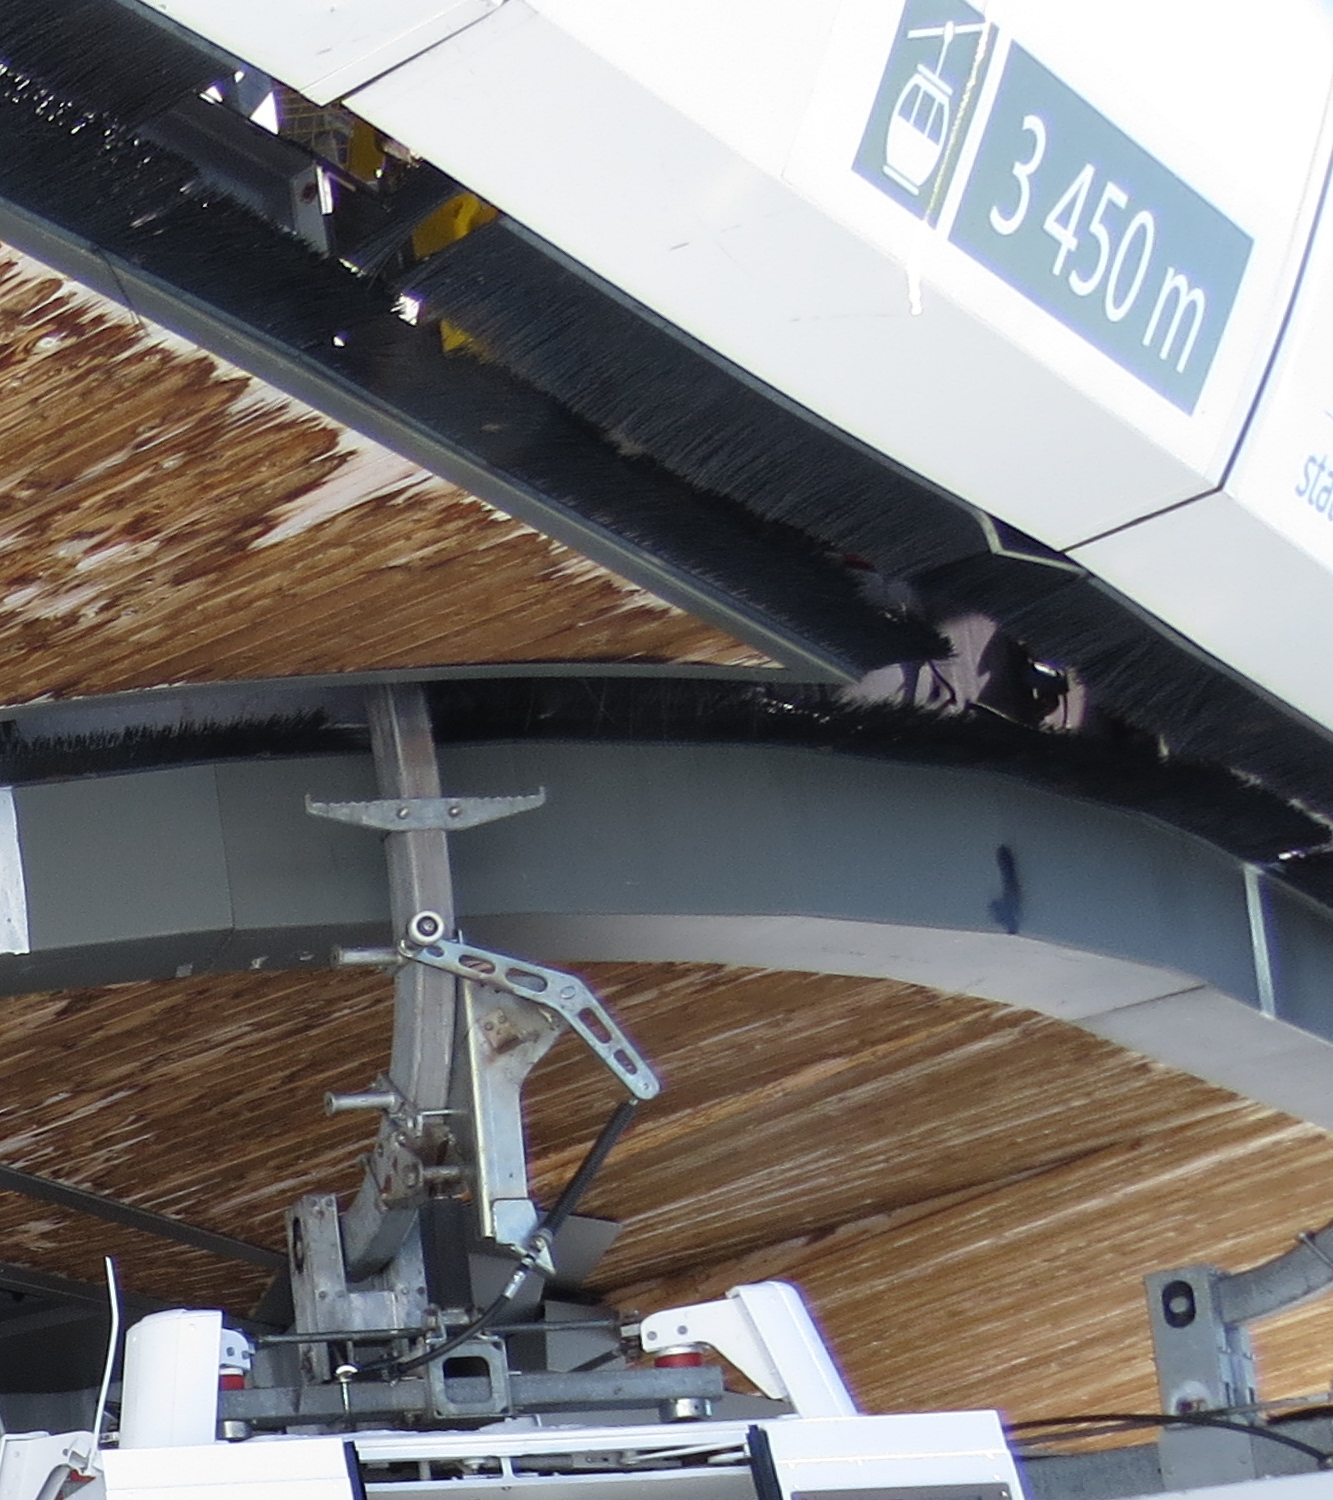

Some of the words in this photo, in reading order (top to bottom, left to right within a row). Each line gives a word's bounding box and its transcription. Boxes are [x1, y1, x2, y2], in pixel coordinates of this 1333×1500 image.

[988, 114, 1047, 236] 3
[1042, 163, 1156, 323] 450
[1141, 266, 1207, 374] m
